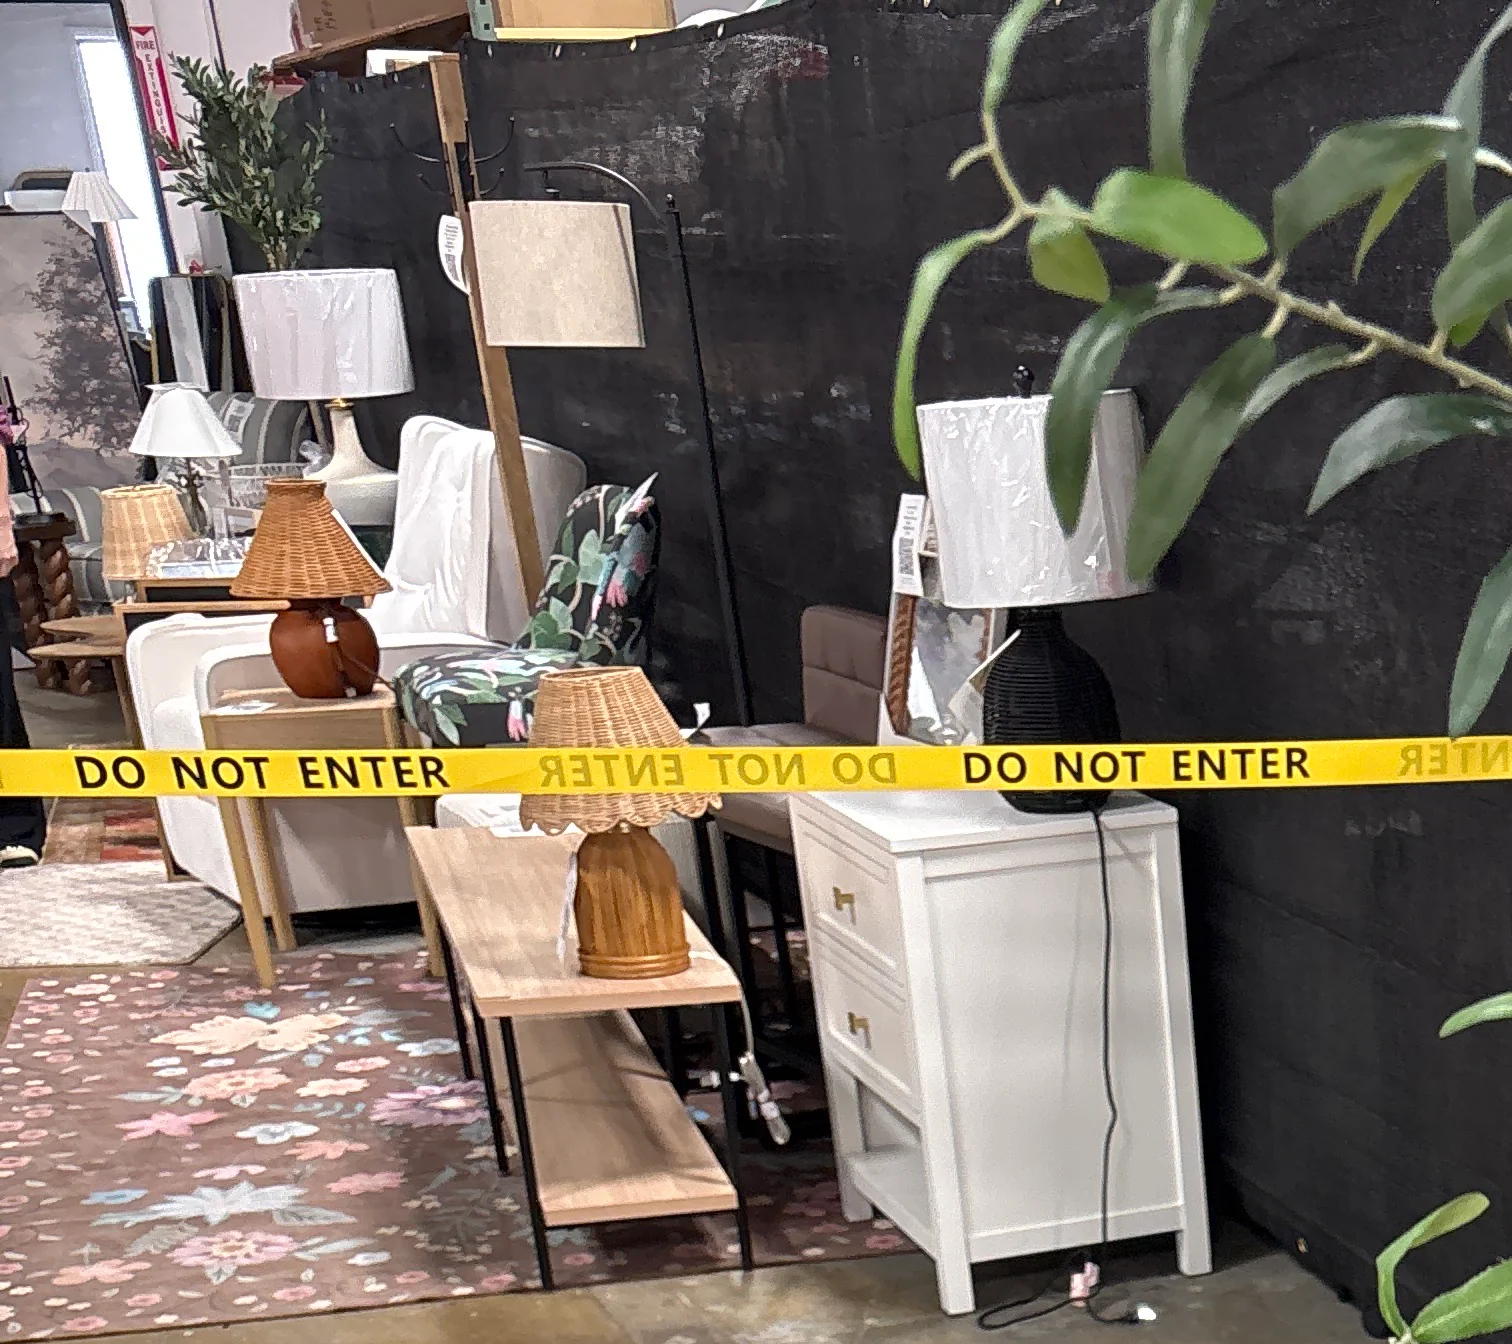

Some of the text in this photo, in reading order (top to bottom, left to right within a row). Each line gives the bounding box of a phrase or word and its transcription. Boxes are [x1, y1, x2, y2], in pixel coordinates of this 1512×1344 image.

[135, 40, 156, 50] FIRE
[144, 53, 167, 134] EXTINGUIS
[74, 755, 450, 790] DO NOT ENTER
[963, 747, 1311, 784] DO NOT ENTER
